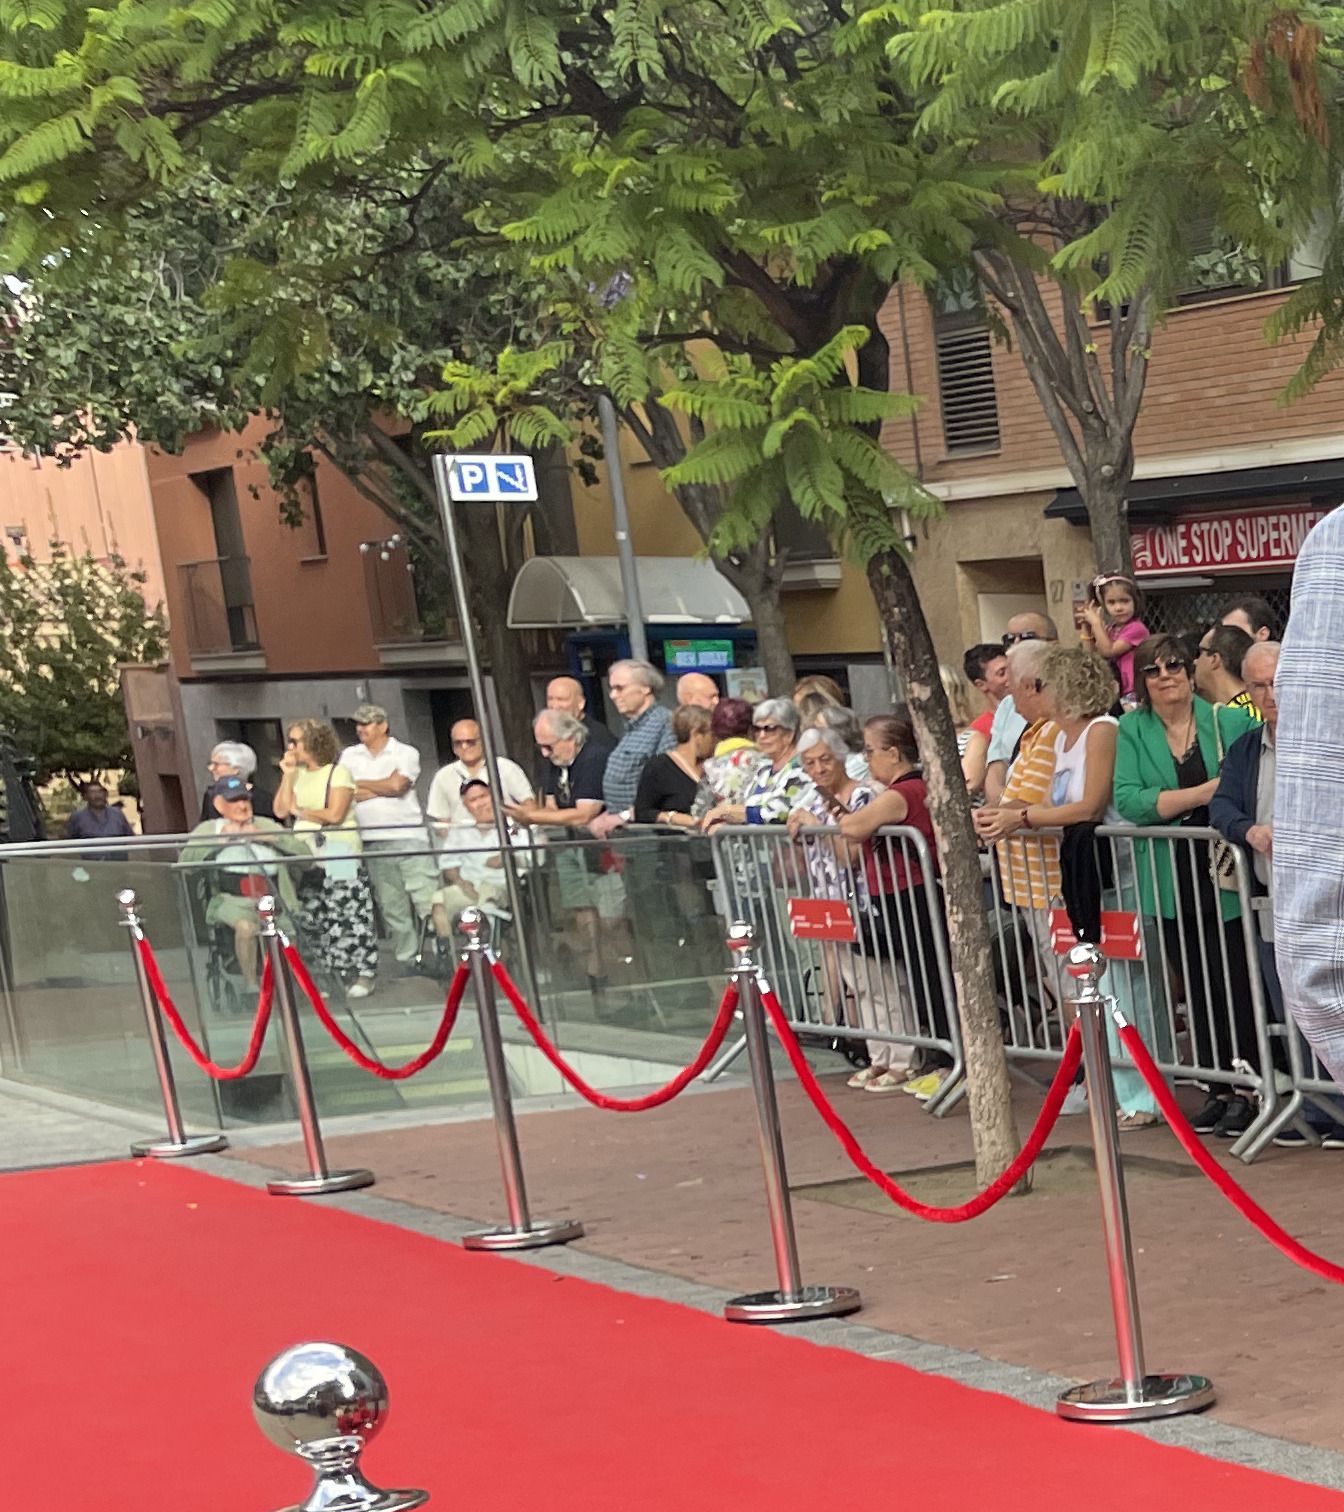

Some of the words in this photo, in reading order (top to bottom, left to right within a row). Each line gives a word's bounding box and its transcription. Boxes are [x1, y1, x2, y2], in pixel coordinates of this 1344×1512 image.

[461, 464, 484, 492] P
[1155, 523, 1189, 567] ONE
[1190, 519, 1233, 563] STOP
